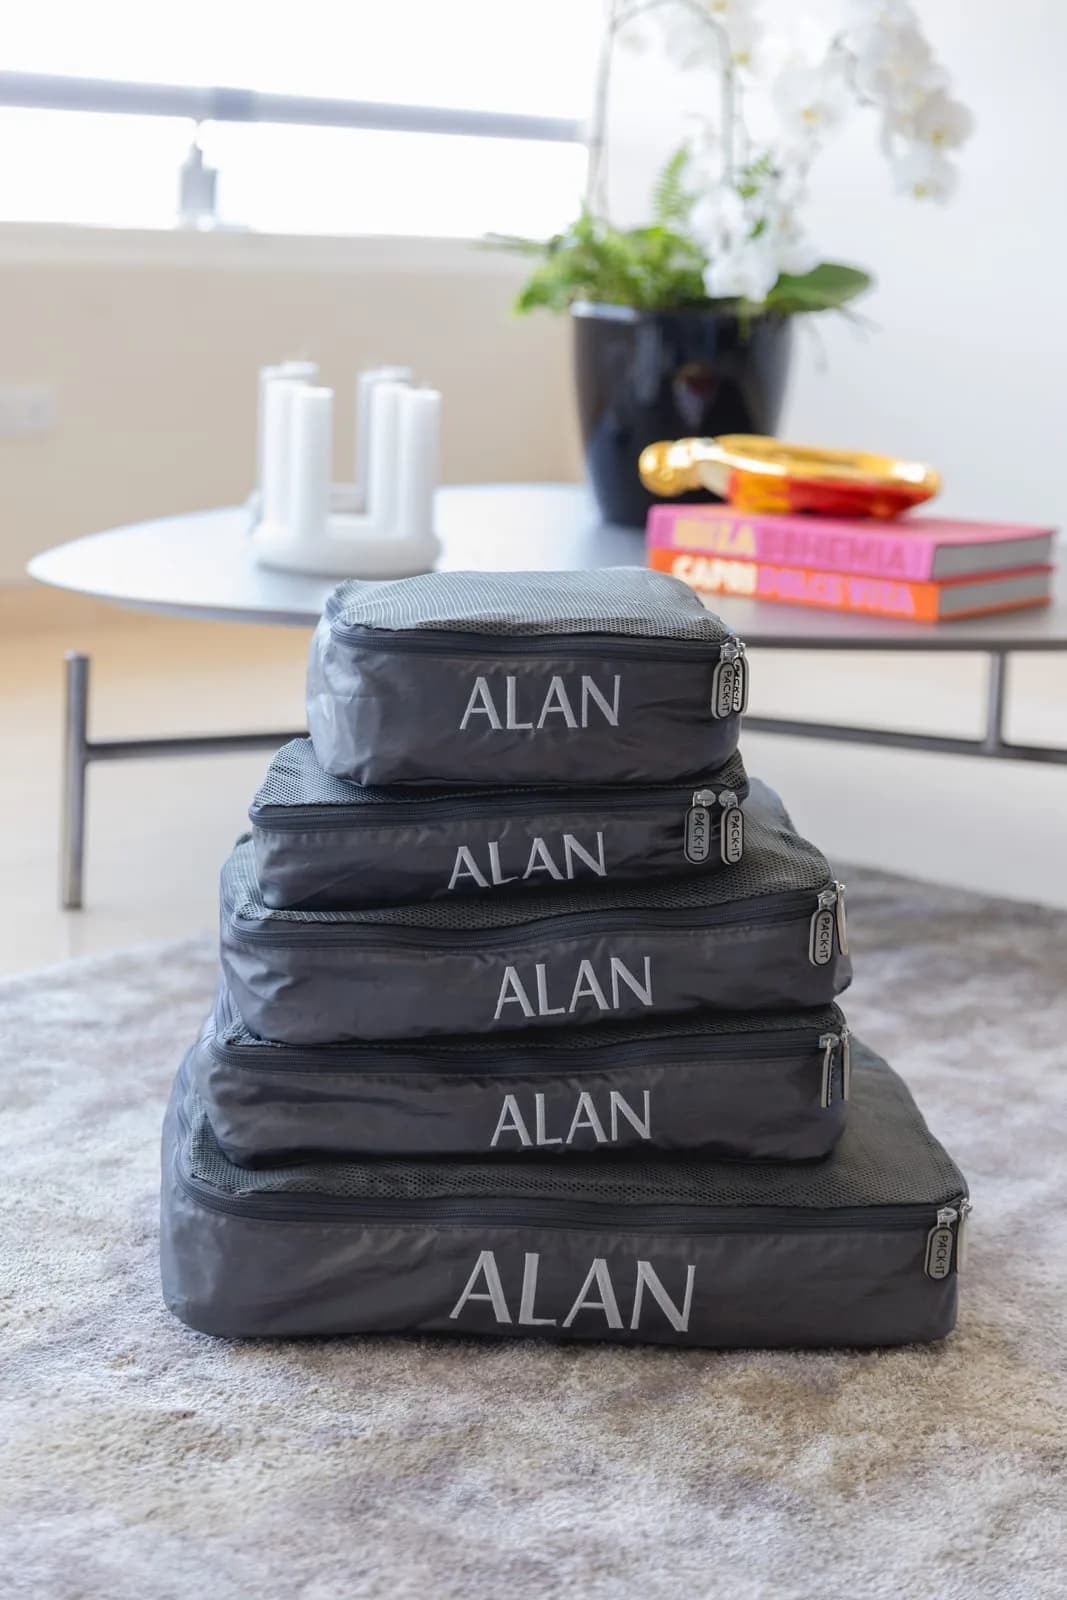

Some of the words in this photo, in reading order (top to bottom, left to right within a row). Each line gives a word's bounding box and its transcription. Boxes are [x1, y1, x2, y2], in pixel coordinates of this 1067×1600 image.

[459, 674, 621, 731] ALAN
[722, 670, 732, 712] PACK-IT
[448, 830, 606, 889] ALAN
[693, 812, 705, 857] PACK-IT
[730, 814, 740, 858] PACK-IT
[819, 916, 830, 960] PACK-IT
[493, 955, 653, 1021] ALAN
[490, 1089, 652, 1147] ALAN
[935, 1234, 949, 1275] PACK-IT
[449, 1250, 696, 1332] ALAN
